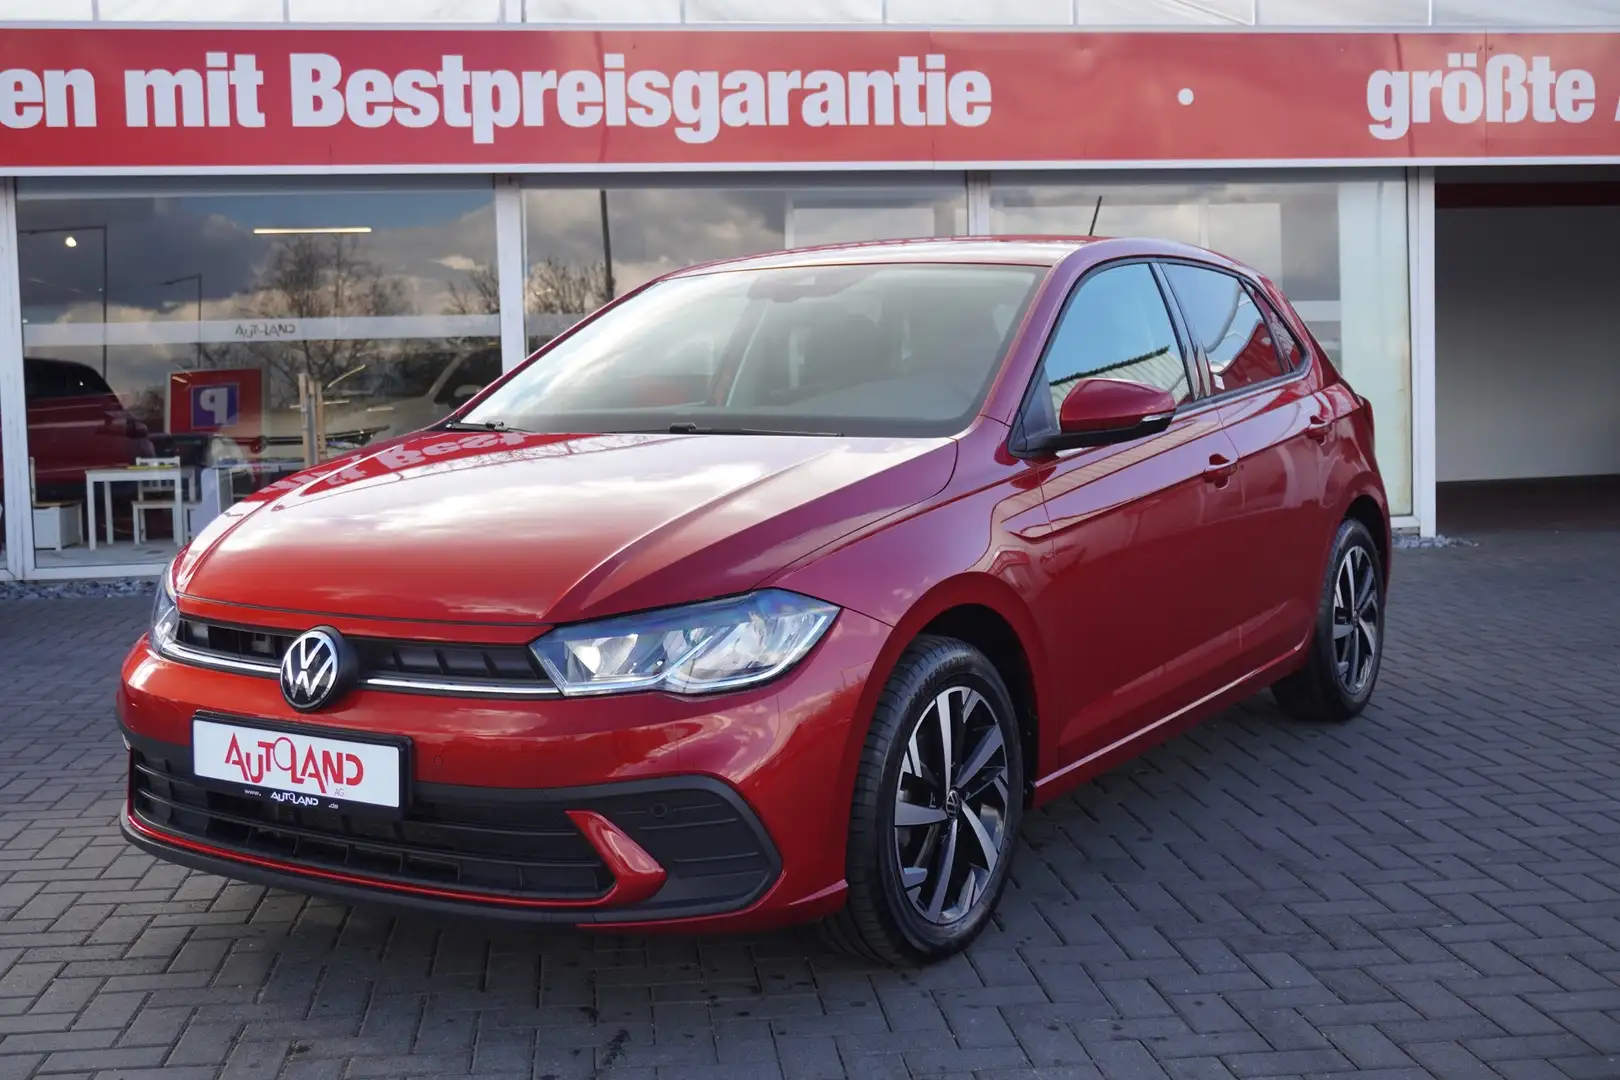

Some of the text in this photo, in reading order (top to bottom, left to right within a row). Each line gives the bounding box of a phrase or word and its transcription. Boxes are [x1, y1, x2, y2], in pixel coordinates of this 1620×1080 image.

[0, 51, 1596, 144] en mit Bestpreisgarantie größte
[224, 732, 364, 794] AUTOLAND
[334, 787, 345, 797] AG
